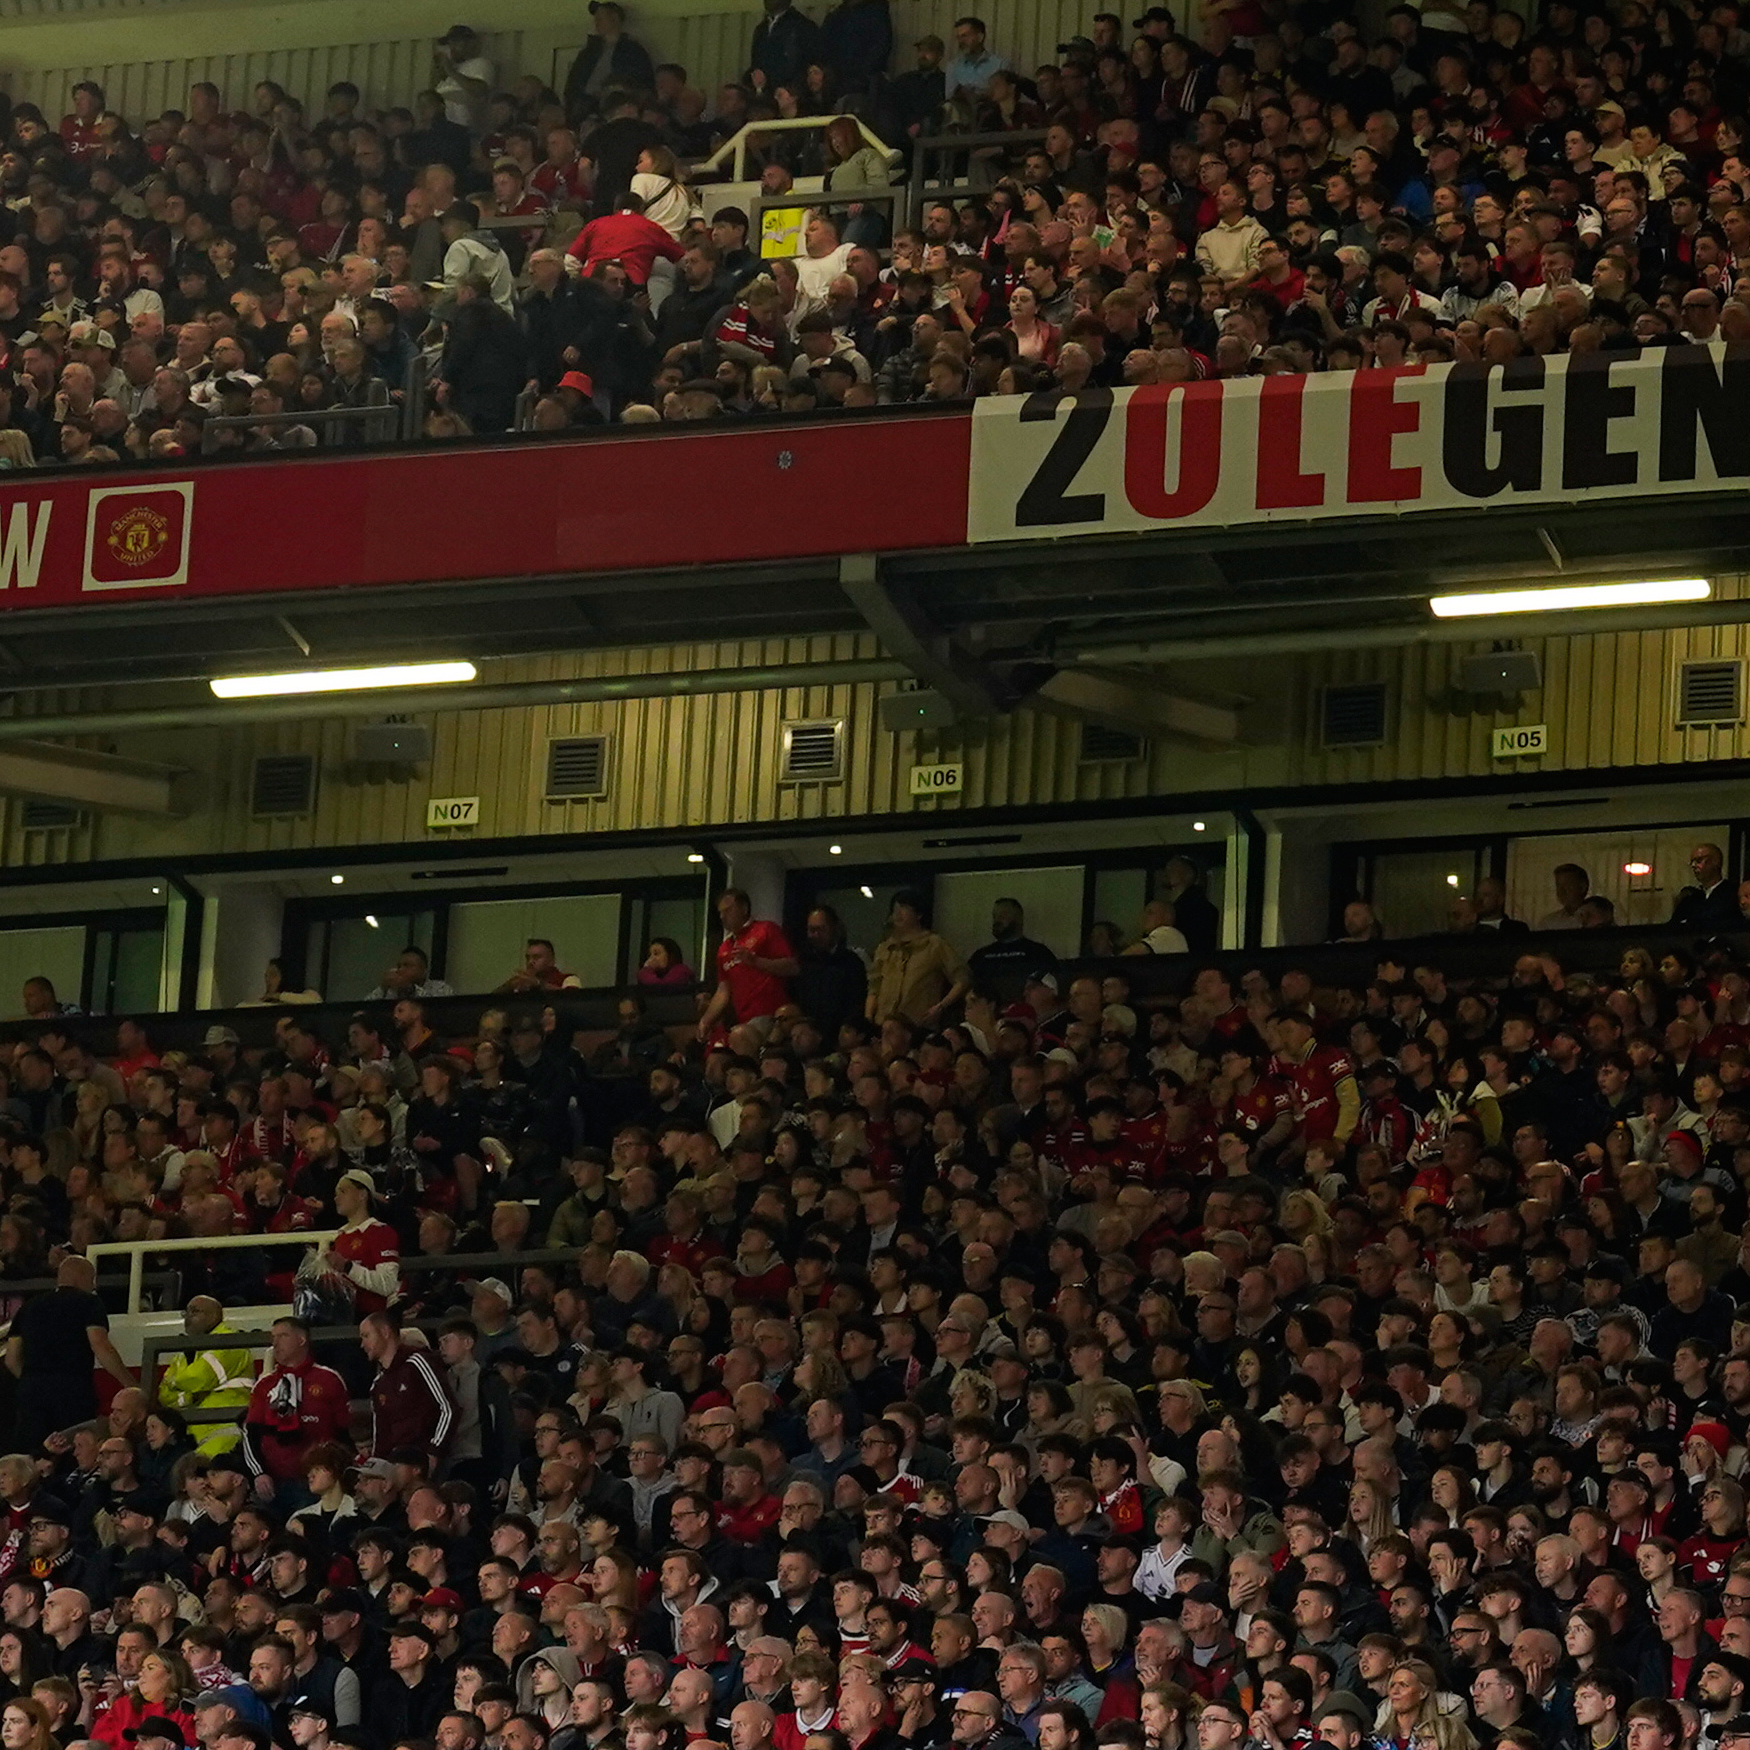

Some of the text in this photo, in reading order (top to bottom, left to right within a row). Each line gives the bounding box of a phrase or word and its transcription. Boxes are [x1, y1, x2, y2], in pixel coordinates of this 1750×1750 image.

[1500, 731, 1542, 750] N05
[918, 769, 957, 787] N06
[434, 803, 474, 820] N07
